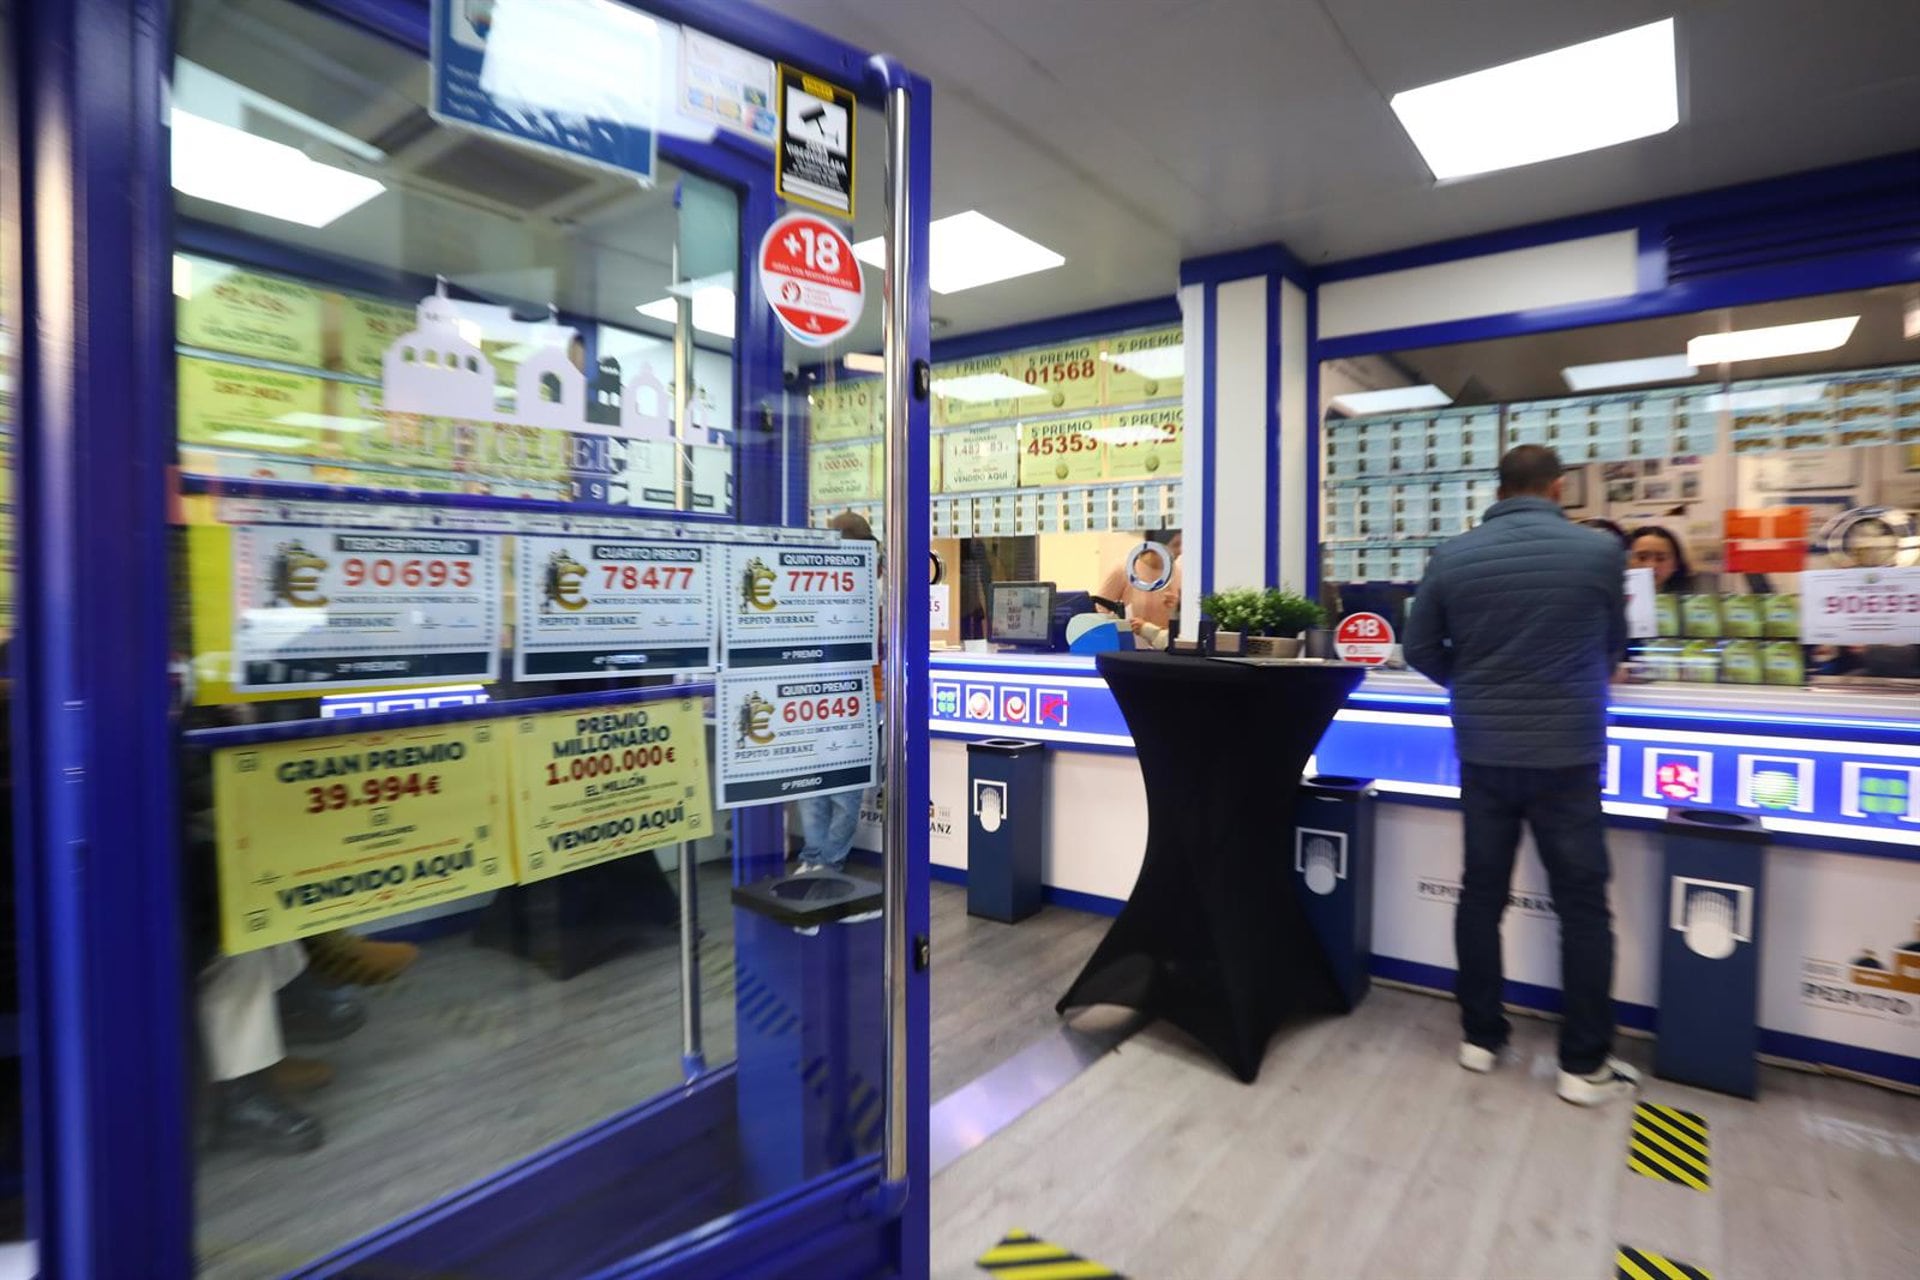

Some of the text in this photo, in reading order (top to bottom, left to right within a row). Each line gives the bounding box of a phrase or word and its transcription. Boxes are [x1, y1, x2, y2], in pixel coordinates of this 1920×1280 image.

[783, 227, 841, 273] +18
[964, 358, 1002, 372] PREMIO
[1029, 347, 1090, 367] 5 PREMIO
[1025, 359, 1095, 385] 01568
[1031, 420, 1092, 438] 5 PREMIO
[1119, 416, 1127, 427] 5
[407, 539, 471, 553] PREMIO
[597, 547, 699, 562] CUARTO PREMIO
[784, 554, 860, 566] QUINTO PREMIO
[343, 558, 472, 587] 90693
[602, 566, 694, 590] 78477
[787, 571, 855, 592] 77715
[538, 616, 637, 626] PEPITO HERRANZ
[738, 616, 772, 625] PEPITO
[774, 615, 815, 625] HERRANZ
[792, 649, 824, 660] PREMIO
[782, 681, 858, 696] QUINTO PREMIO
[783, 696, 860, 723] 60649
[576, 711, 648, 736] PREMIO
[553, 726, 671, 758] MILLONARIO
[735, 749, 770, 759] PEPITO
[773, 744, 814, 756] HERRANZ
[277, 742, 466, 783] GRAN PREMIO
[586, 784, 600, 797] EL
[604, 772, 647, 791] MILLÓN
[791, 777, 823, 789] PREMIO
[548, 817, 634, 852] VENDIDO
[639, 801, 685, 831] AQUÍ
[277, 864, 405, 909] VENDIDO
[412, 843, 474, 881] AQUÍ
